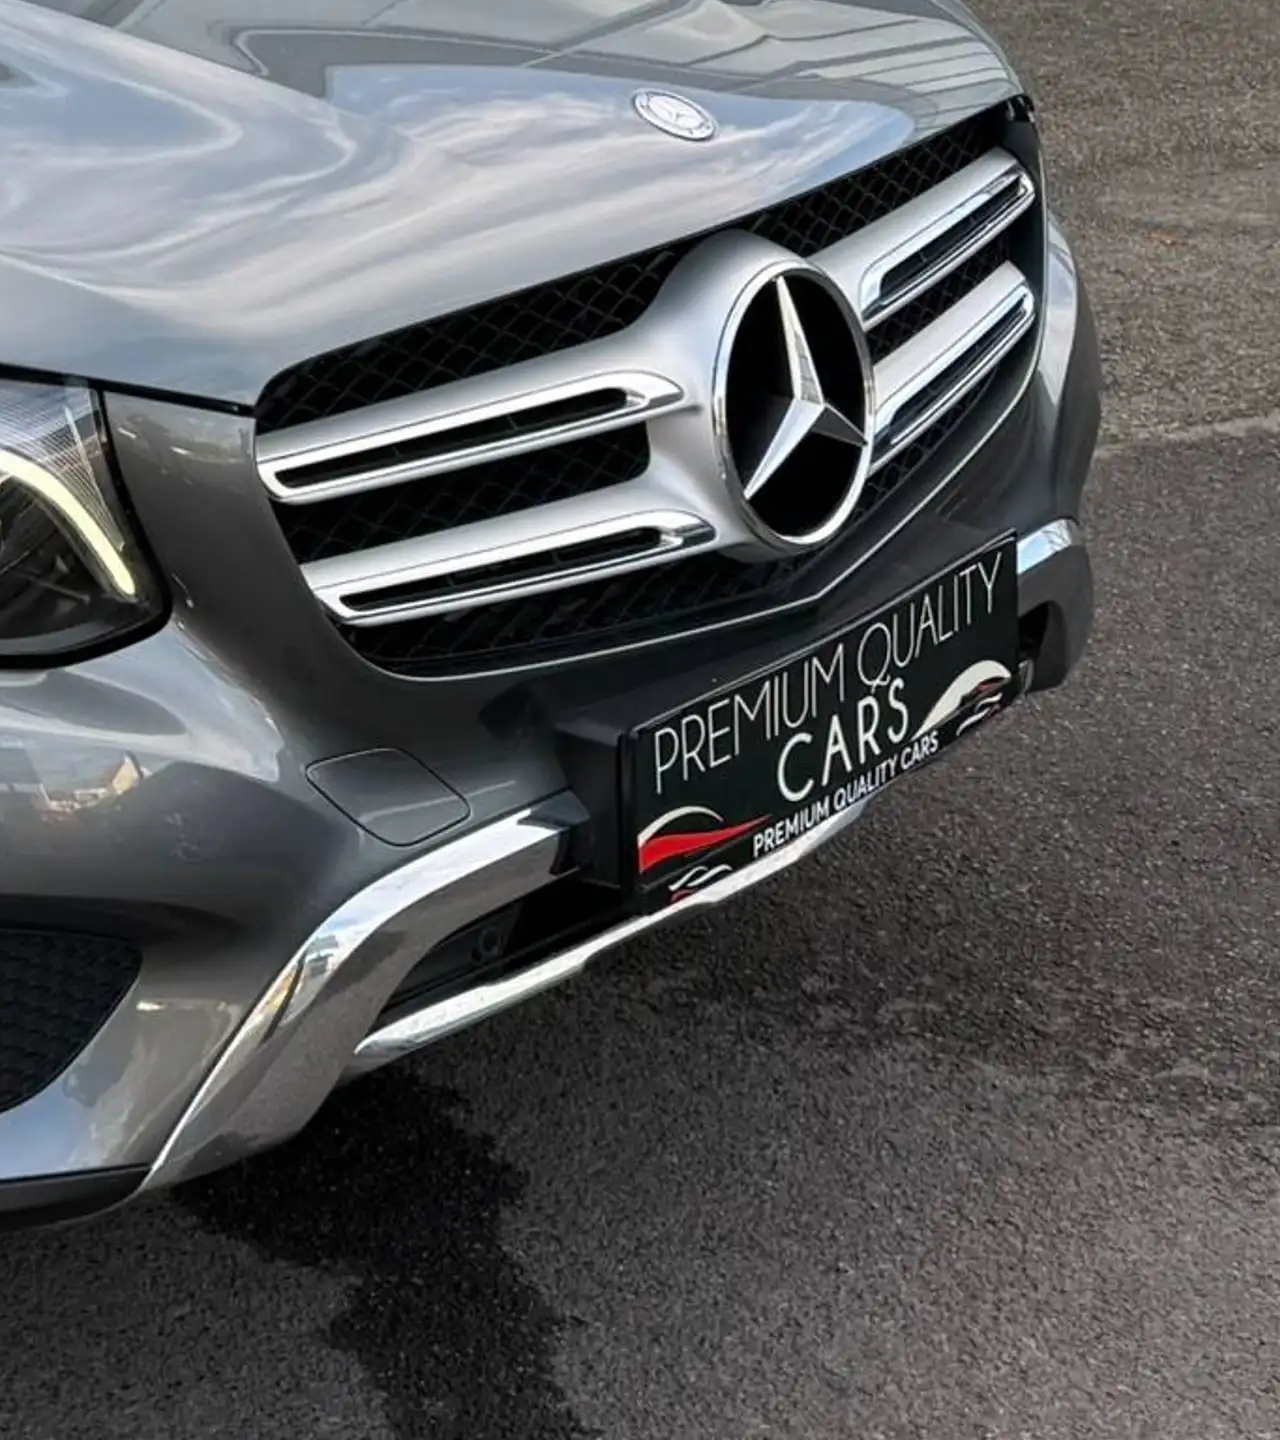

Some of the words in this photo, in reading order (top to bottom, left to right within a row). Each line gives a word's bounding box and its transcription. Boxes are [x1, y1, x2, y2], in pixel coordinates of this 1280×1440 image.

[653, 642, 845, 795] PREMIUM
[856, 551, 1003, 694] QUALITY
[752, 795, 831, 858] PREMIUM
[832, 754, 897, 810] QUALITY
[899, 730, 940, 771] CARS
[777, 676, 909, 803] CARS
